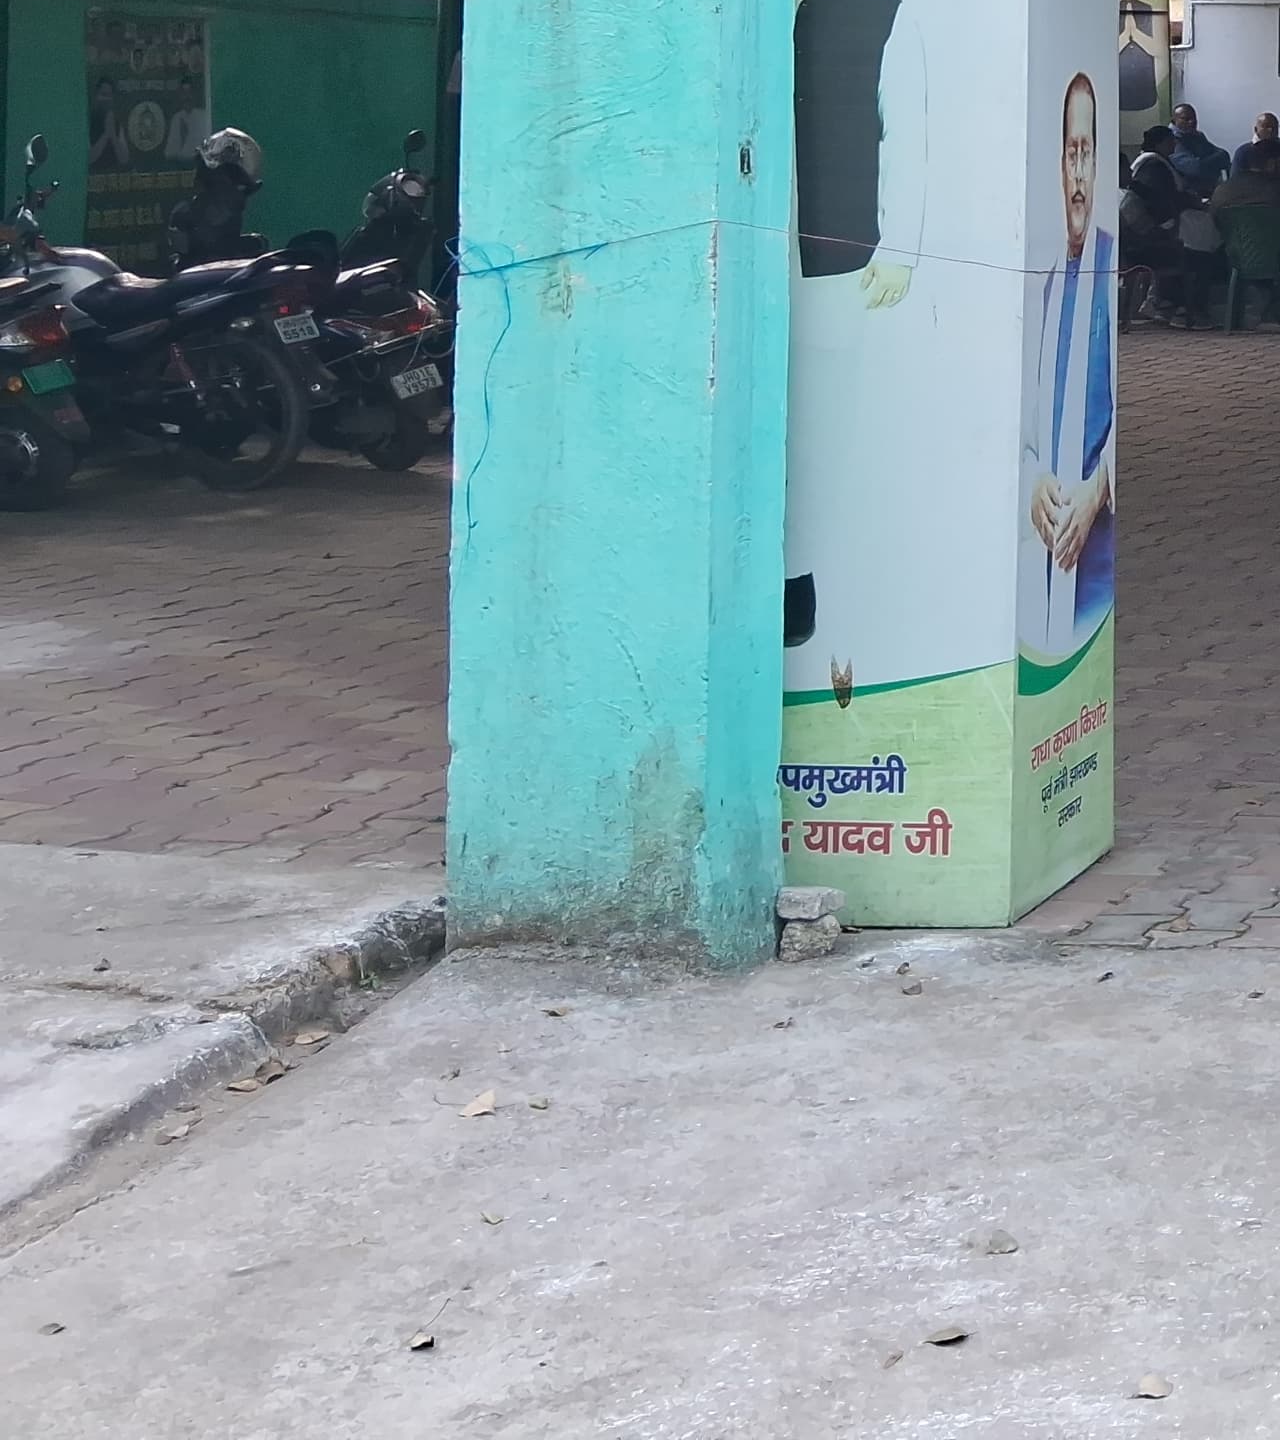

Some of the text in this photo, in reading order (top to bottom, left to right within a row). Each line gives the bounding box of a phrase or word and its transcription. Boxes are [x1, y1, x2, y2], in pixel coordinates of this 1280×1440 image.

[1080, 697, 1107, 737] किशोर
[803, 820, 894, 854] यादव
[902, 808, 952, 856] जी
